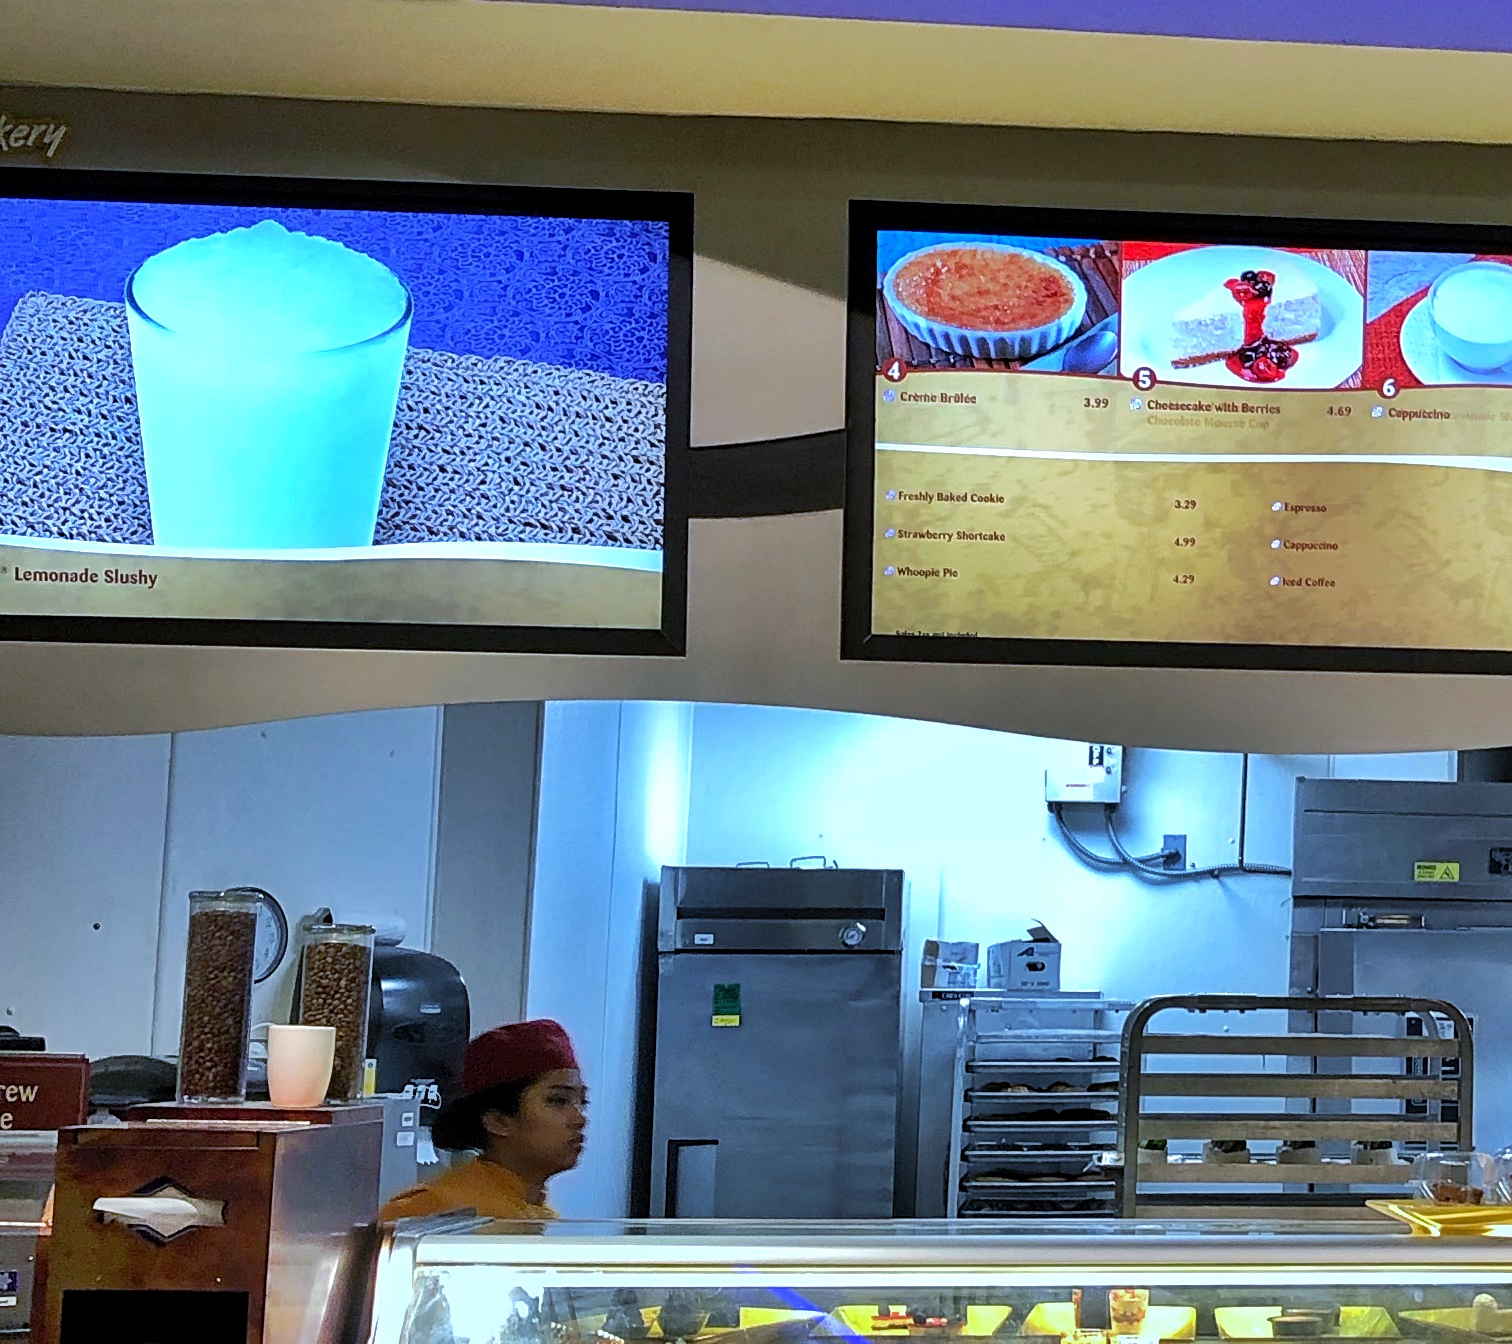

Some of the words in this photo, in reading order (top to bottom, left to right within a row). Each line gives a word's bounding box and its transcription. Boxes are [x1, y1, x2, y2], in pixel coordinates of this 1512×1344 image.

[887, 362, 900, 380] 4
[1138, 370, 1151, 388] 5
[1382, 379, 1396, 398] 6
[1083, 397, 1109, 409] 3.99
[1147, 399, 1212, 413] Cheesecake
[1214, 401, 1238, 413] with
[1241, 403, 1281, 415] Berries
[1326, 406, 1352, 417] 4.69
[1388, 408, 1451, 421] Cappuccino
[898, 491, 934, 504] Freshly
[937, 492, 968, 503] Baked
[970, 493, 1005, 504] Cookie
[1174, 499, 1197, 510] 3.29
[1283, 502, 1327, 514] Espresso
[898, 529, 953, 543] Strawberry
[956, 531, 1006, 542] Shortcake
[1174, 537, 1196, 548] 4.99
[1283, 540, 1338, 553] Cappuccino
[14, 566, 99, 584] Lemonade
[104, 569, 158, 589] Slushy
[897, 567, 940, 580] Whoopie
[943, 568, 958, 578] Pie
[1173, 574, 1195, 585] 4.29
[1282, 577, 1302, 587] Iced
[1305, 577, 1336, 588] Coffee
